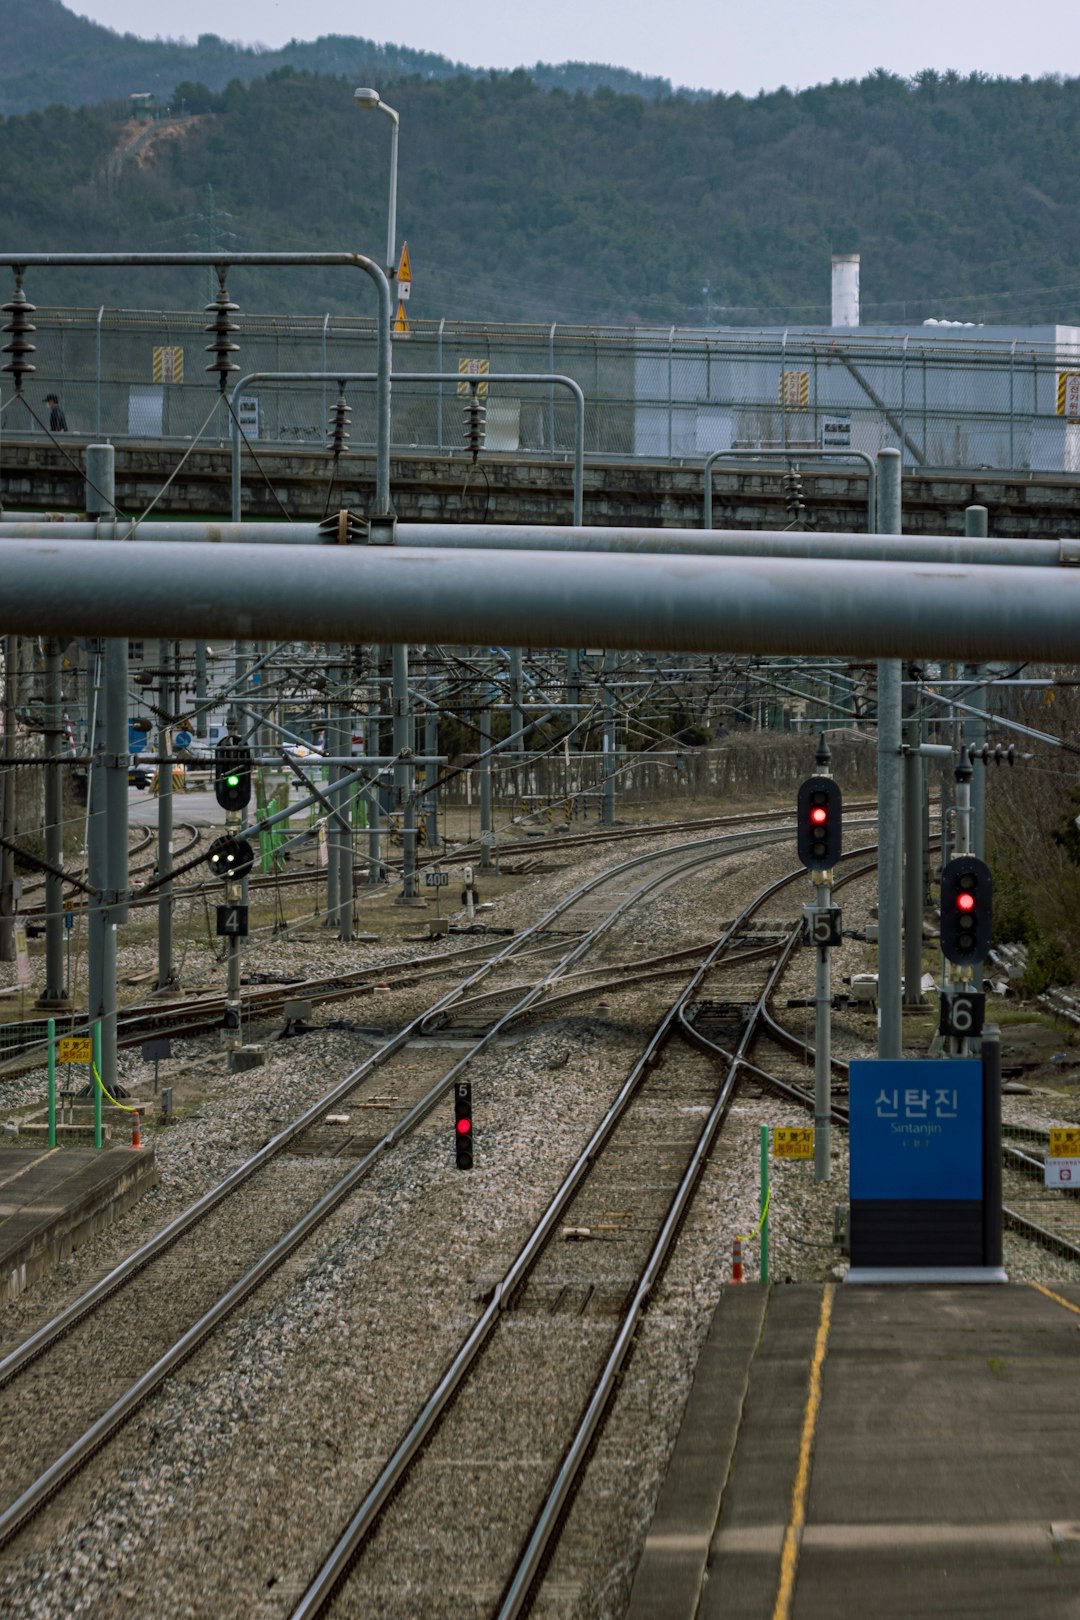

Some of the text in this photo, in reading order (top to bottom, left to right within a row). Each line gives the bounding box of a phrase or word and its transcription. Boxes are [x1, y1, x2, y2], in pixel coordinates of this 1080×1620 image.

[426, 874, 447, 886] 400
[225, 909, 239, 932] 4
[814, 914, 831, 941] 5
[952, 998, 973, 1031] 6
[459, 1084, 468, 1096] 5
[874, 1088, 958, 1118] 신탄진
[891, 1122, 942, 1136] Sintanjin
